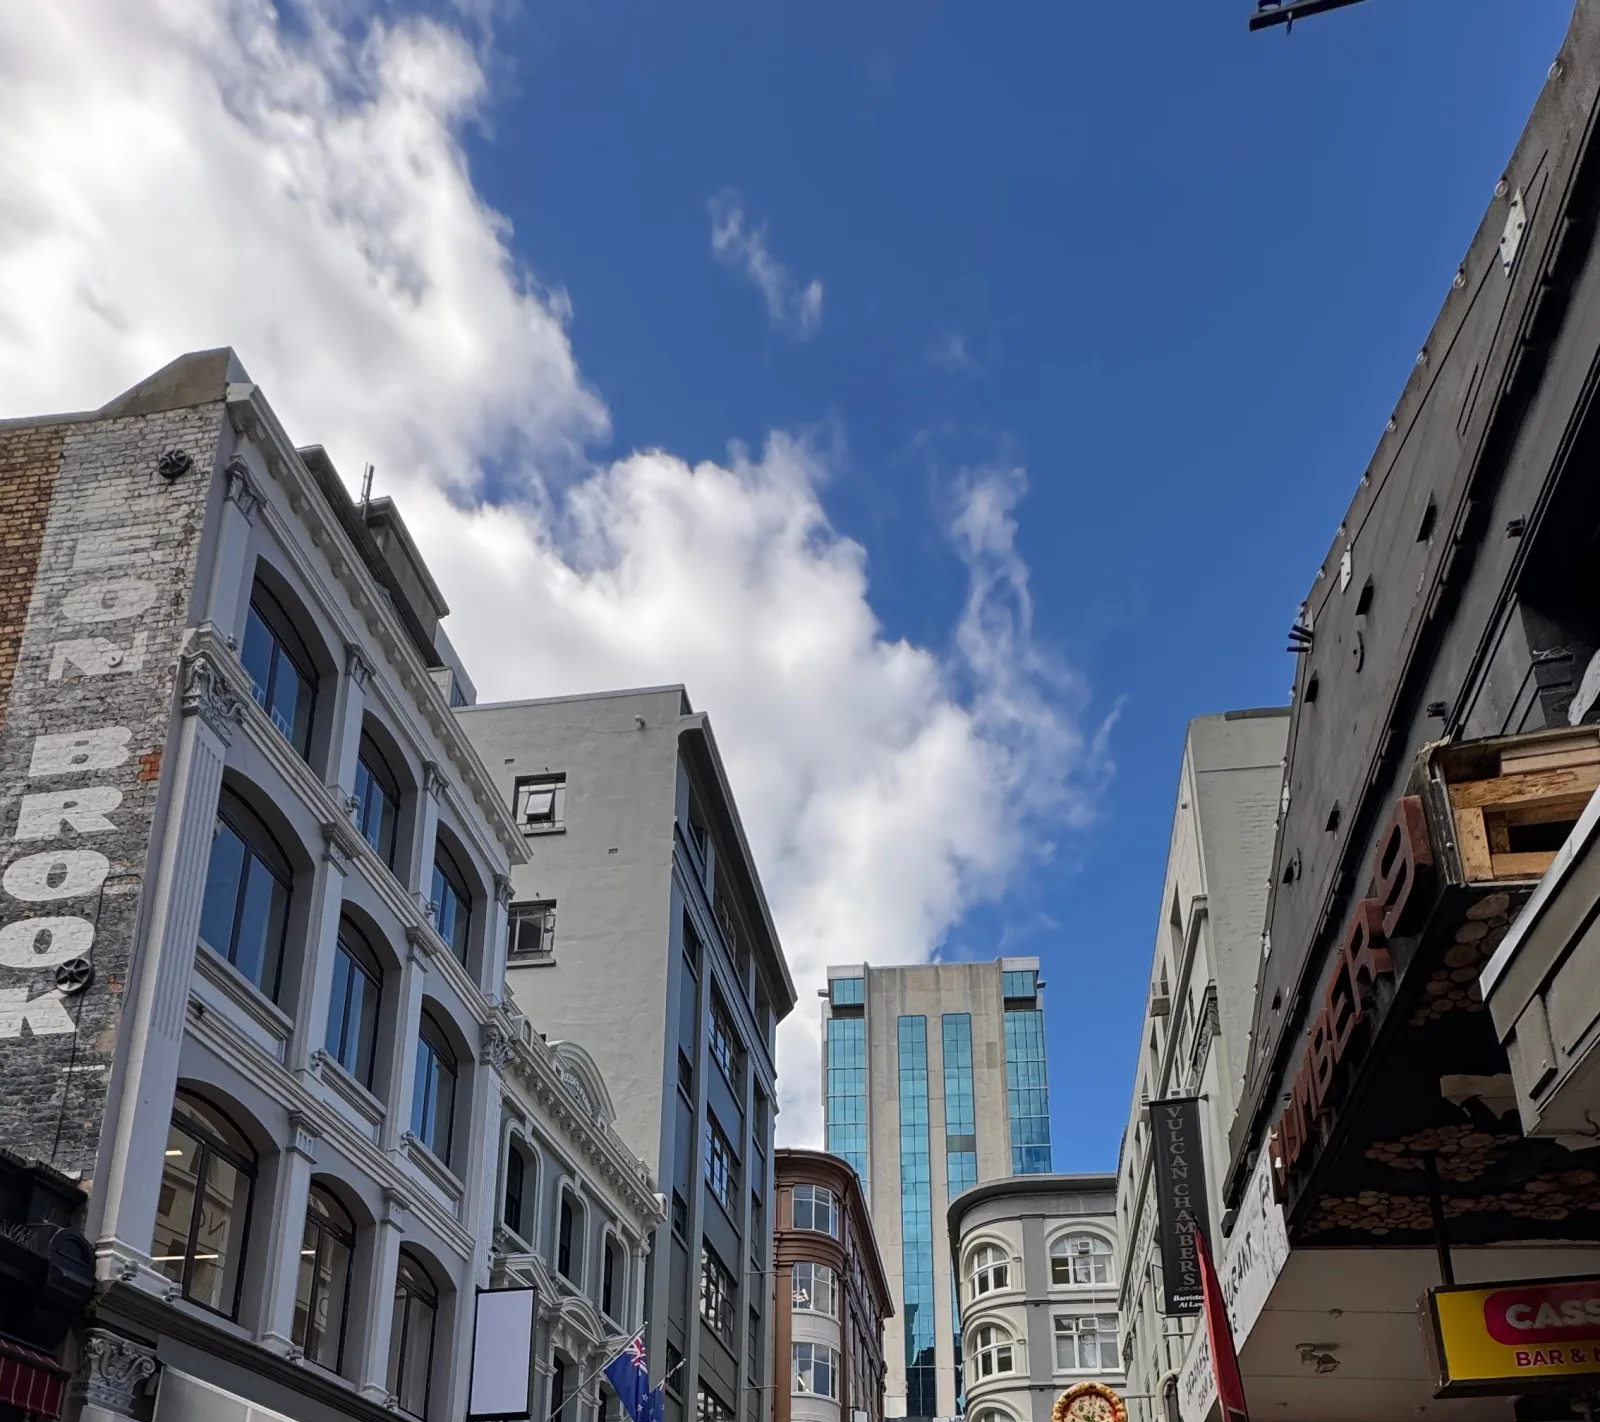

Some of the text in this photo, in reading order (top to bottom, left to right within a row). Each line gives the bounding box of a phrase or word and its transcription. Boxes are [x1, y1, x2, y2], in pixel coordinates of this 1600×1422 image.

[1165, 1107, 1199, 1286] VULCAN CHAMBERS
[1178, 1301, 1188, 1309] At
[1515, 1349, 1564, 1367] BAR
[1571, 1347, 1587, 1364] &
